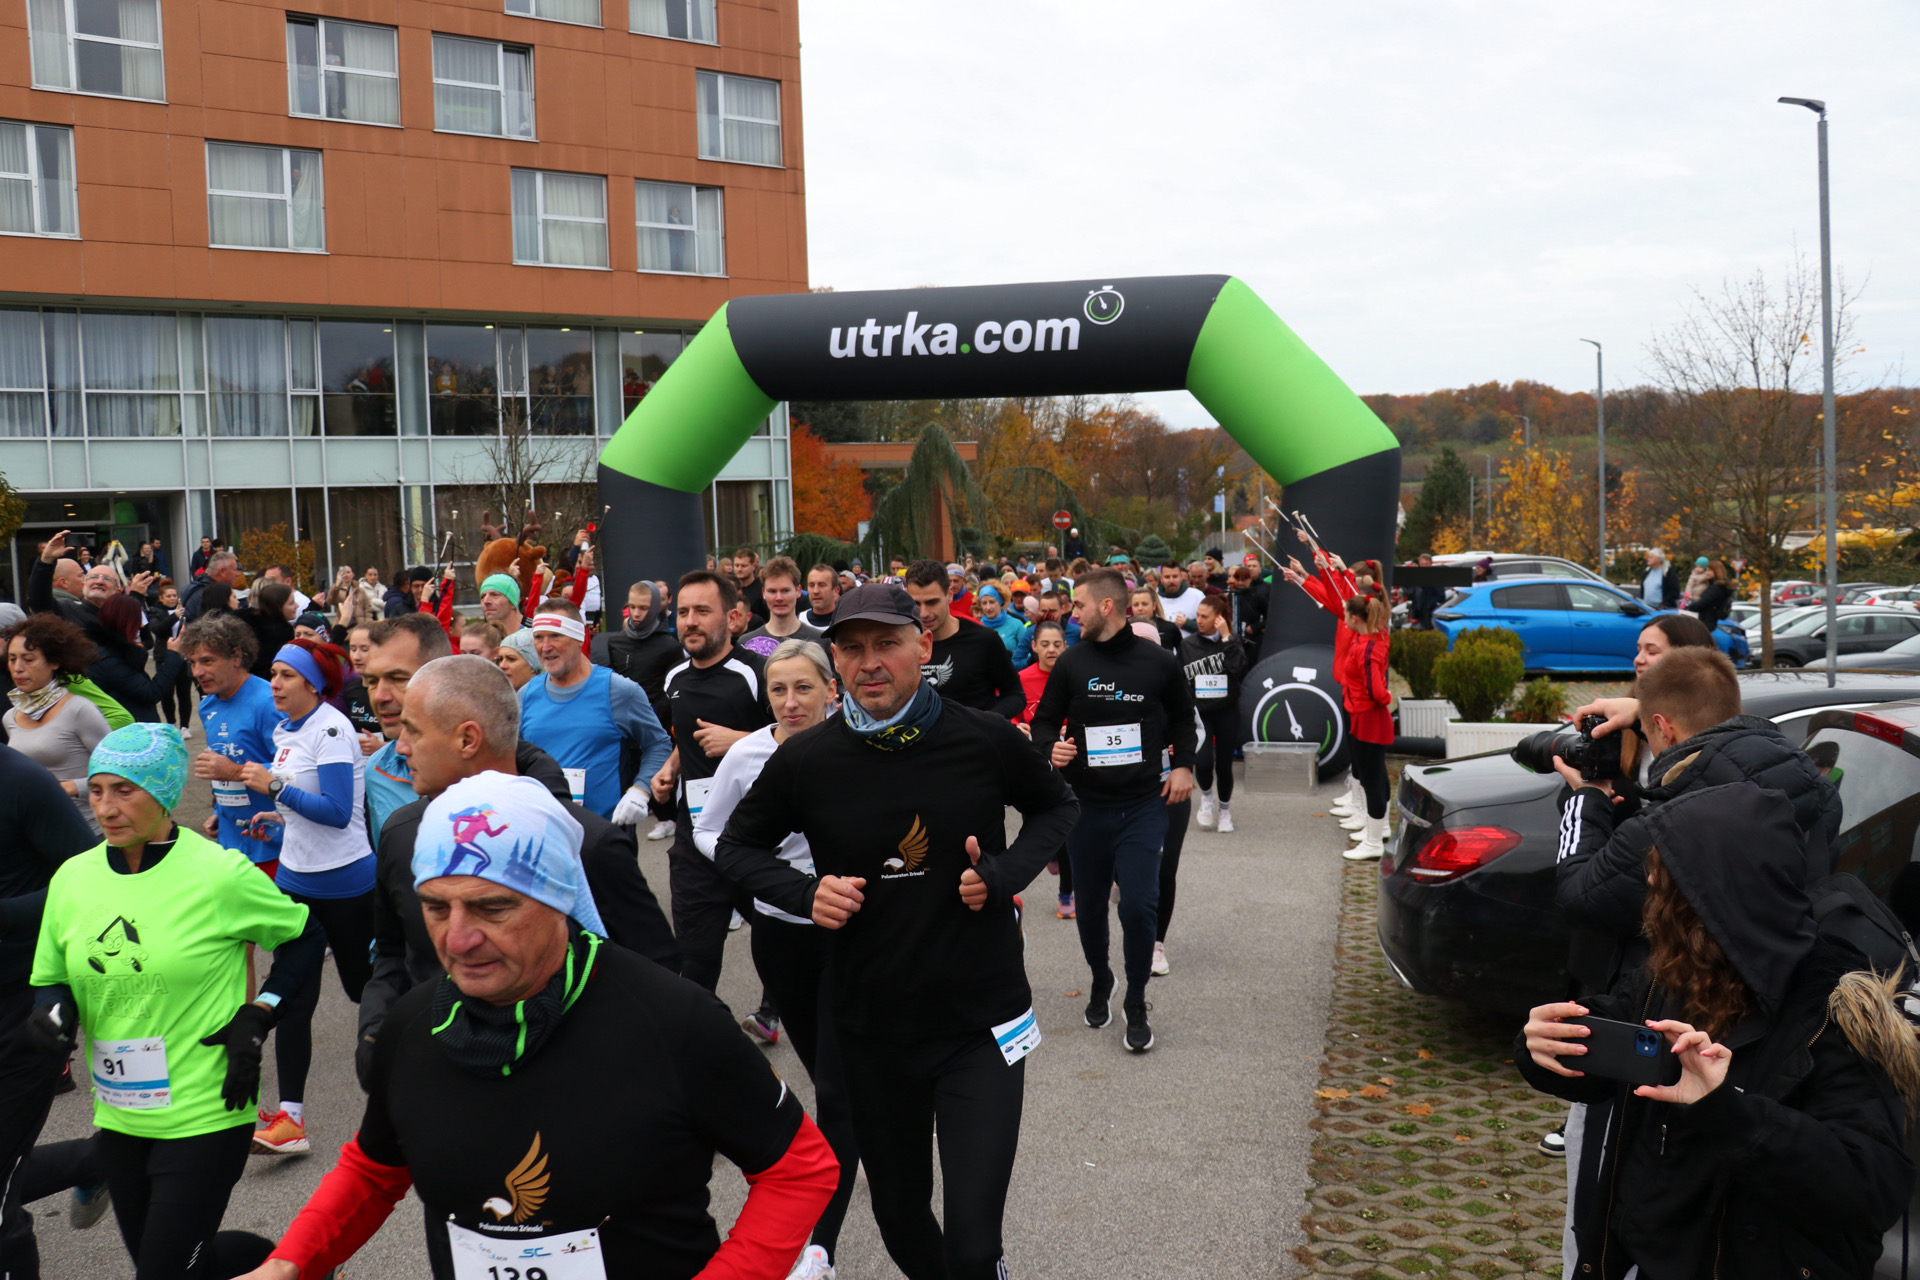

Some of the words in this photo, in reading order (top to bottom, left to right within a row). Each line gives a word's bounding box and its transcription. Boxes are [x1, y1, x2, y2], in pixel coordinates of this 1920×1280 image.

[829, 311, 1081, 359] utrka.com
[1087, 677, 1115, 691] Fund
[1115, 690, 1144, 702] Race
[1106, 735, 1122, 746] 35
[103, 1058, 125, 1076] 91
[518, 1247, 552, 1259] SC
